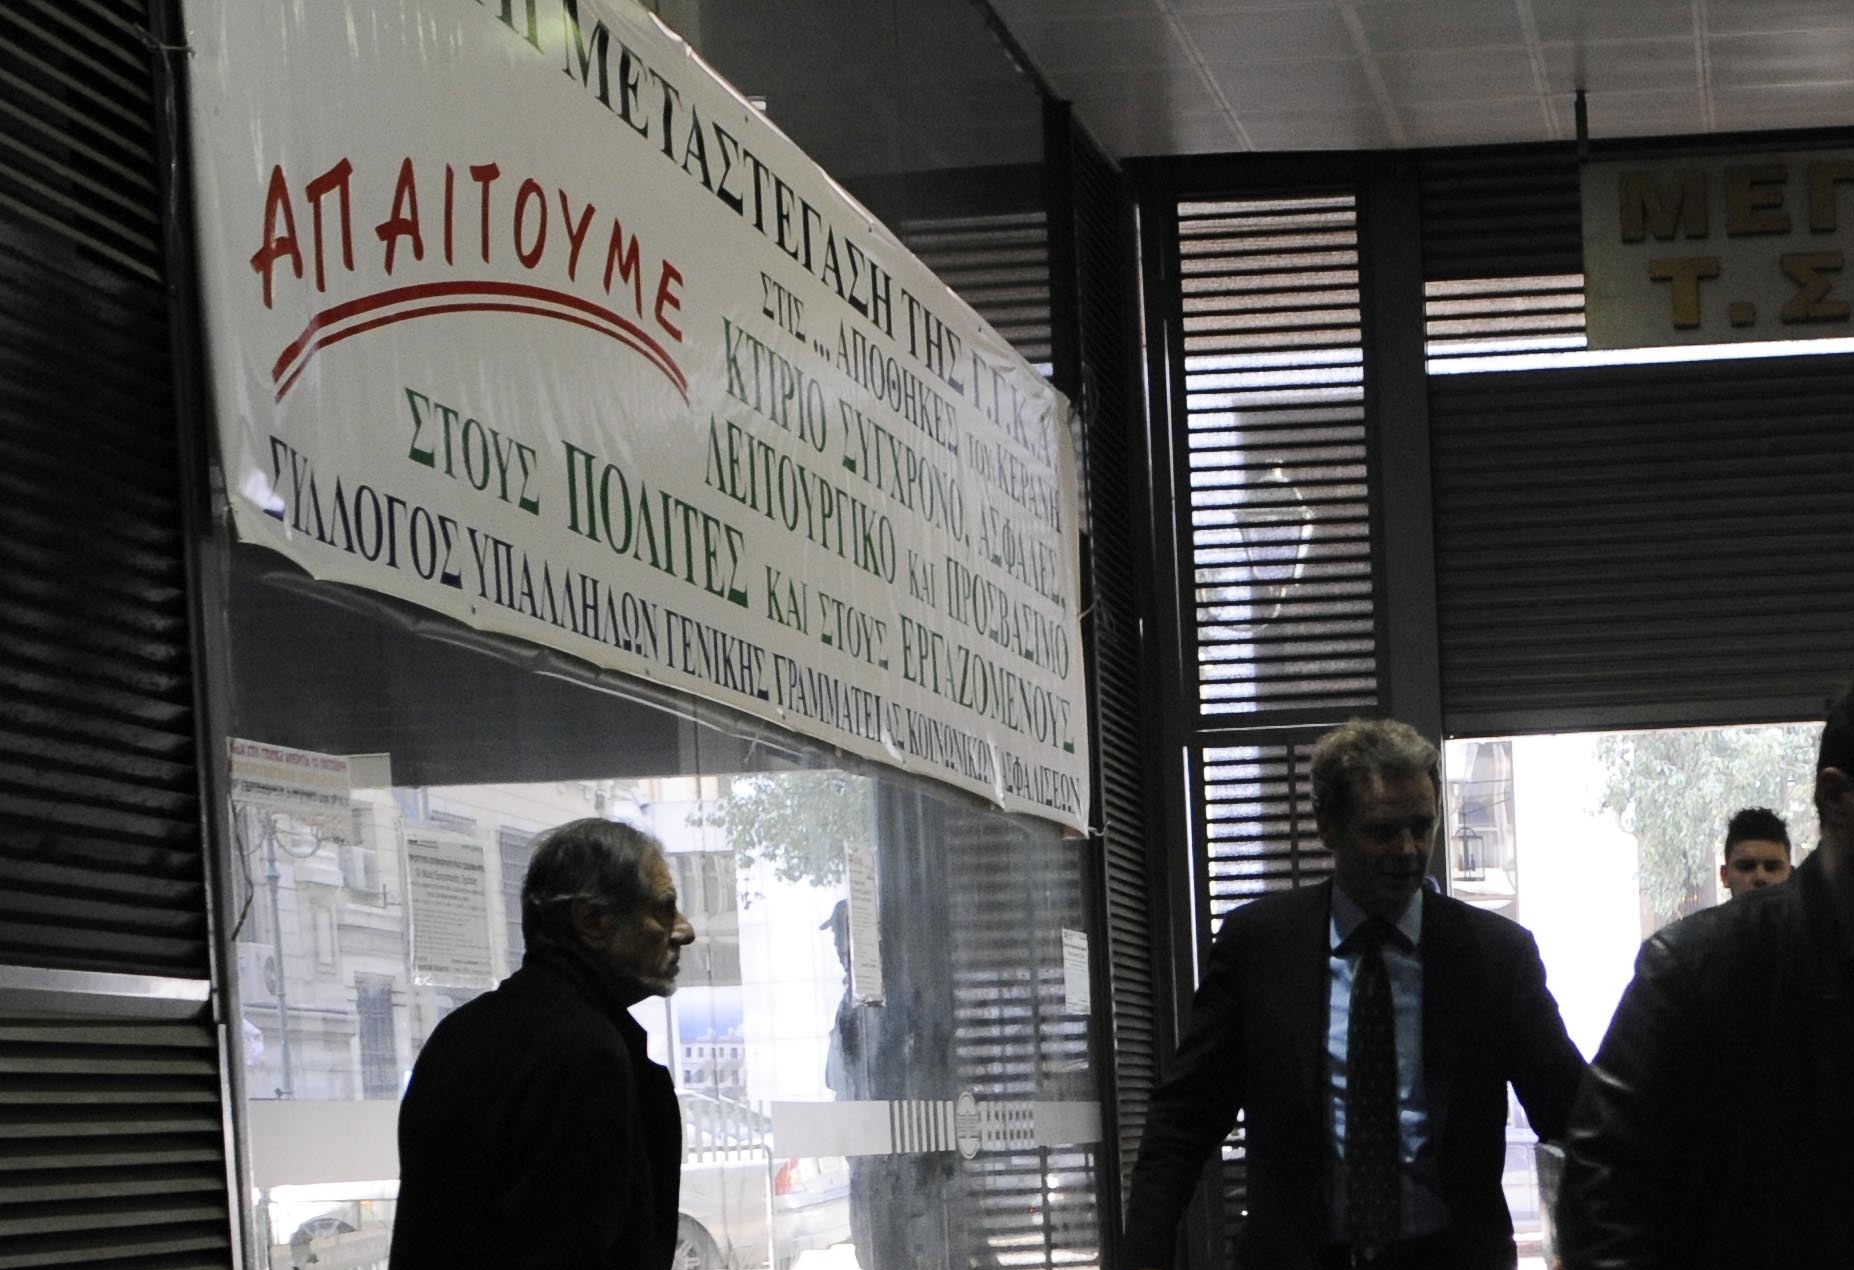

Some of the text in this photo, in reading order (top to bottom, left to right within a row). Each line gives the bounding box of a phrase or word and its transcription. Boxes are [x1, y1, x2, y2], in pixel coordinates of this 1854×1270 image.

[250, 157, 684, 343] ΑΠΑΙΤΟΥΜΕ
[562, 0, 896, 341] ΜΕΤΑΣΤΕΓΑΣΗ
[901, 287, 964, 396] ΤΗΣ
[760, 271, 806, 343] ΣΤΙΣ
[721, 316, 826, 453] ΚΤΙΡΙΟ
[263, 434, 1081, 817] ΣΥΛΛΟΓΟΣ ΥΠΑΛΛΗΛΩΝ ΓΕΝΙΚΗΣ ΓΡΑΜΜΑΤΕΙΑΣ ΚΟΙΝΩΝΙΚΩΝ ΑΣΦΑΛΙΣΕΩΝ
[404, 386, 1075, 754] ΣΤΟΥΣ ΠΟΛΙΤΕΣ ΚΑΙ ΣΤΟΥΣ ΕΡΓΑΖΟΜΕΝΟΥΣ
[705, 414, 1069, 680] ΛΕΙΤΟΥΡΓΙΚΟ ΚΑΙ ΠΡΟΣΒΑΣΙΜΟ
